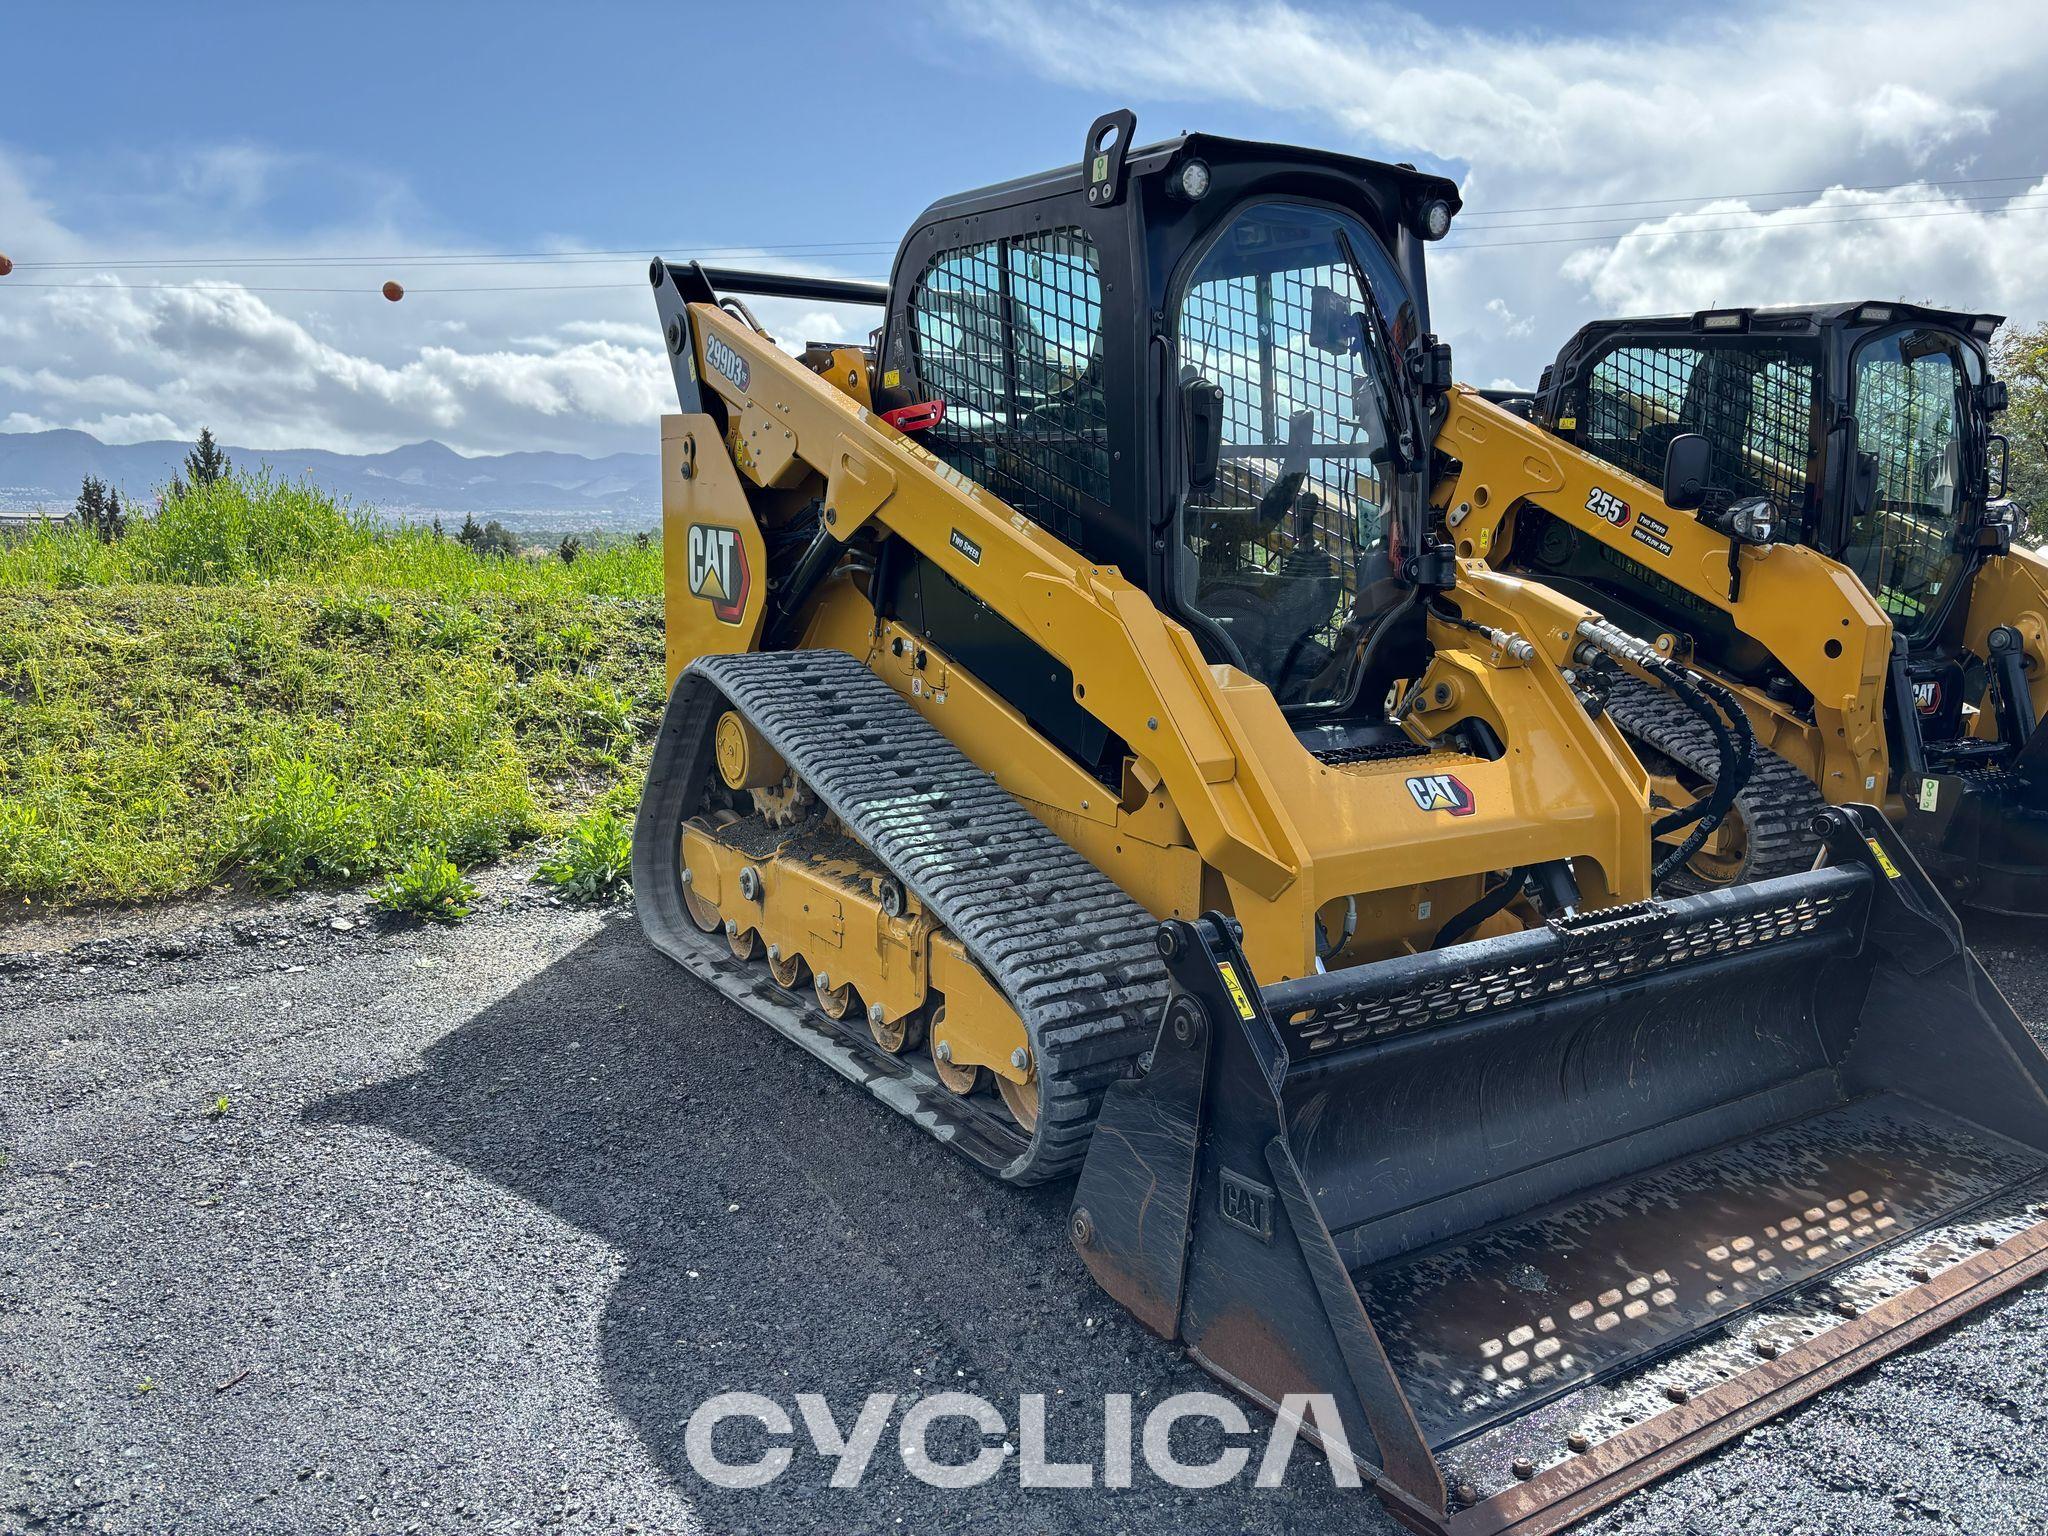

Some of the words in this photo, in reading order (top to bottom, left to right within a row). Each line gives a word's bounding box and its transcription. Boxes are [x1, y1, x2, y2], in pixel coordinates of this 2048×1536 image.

[706, 335, 742, 386] 299D3
[1586, 488, 1624, 522] 255
[689, 526, 734, 600] CAT
[1406, 775, 1461, 810] CAT
[1223, 1182, 1264, 1233] CAT
